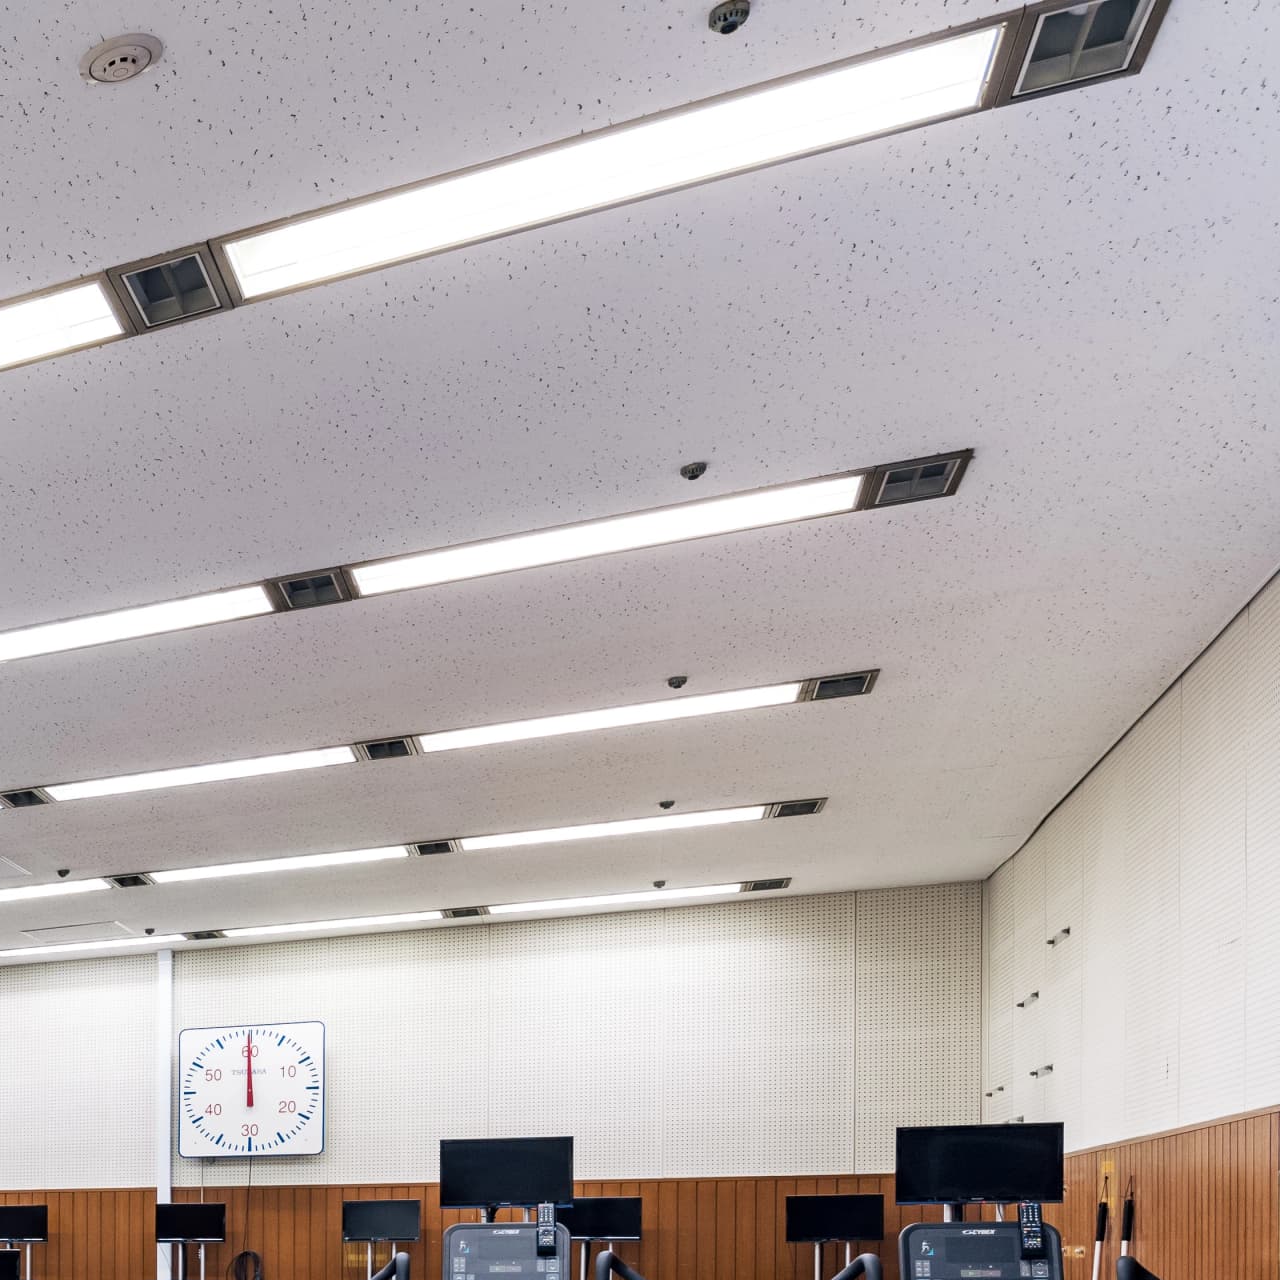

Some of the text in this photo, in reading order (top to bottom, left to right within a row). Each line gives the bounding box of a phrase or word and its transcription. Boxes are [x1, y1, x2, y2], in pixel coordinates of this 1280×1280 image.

[241, 1045, 259, 1058] 60
[205, 1068, 222, 1081] 50
[280, 1065, 297, 1078] 10
[205, 1103, 222, 1116] 40
[278, 1100, 297, 1113] 20
[241, 1123, 259, 1136] 30
